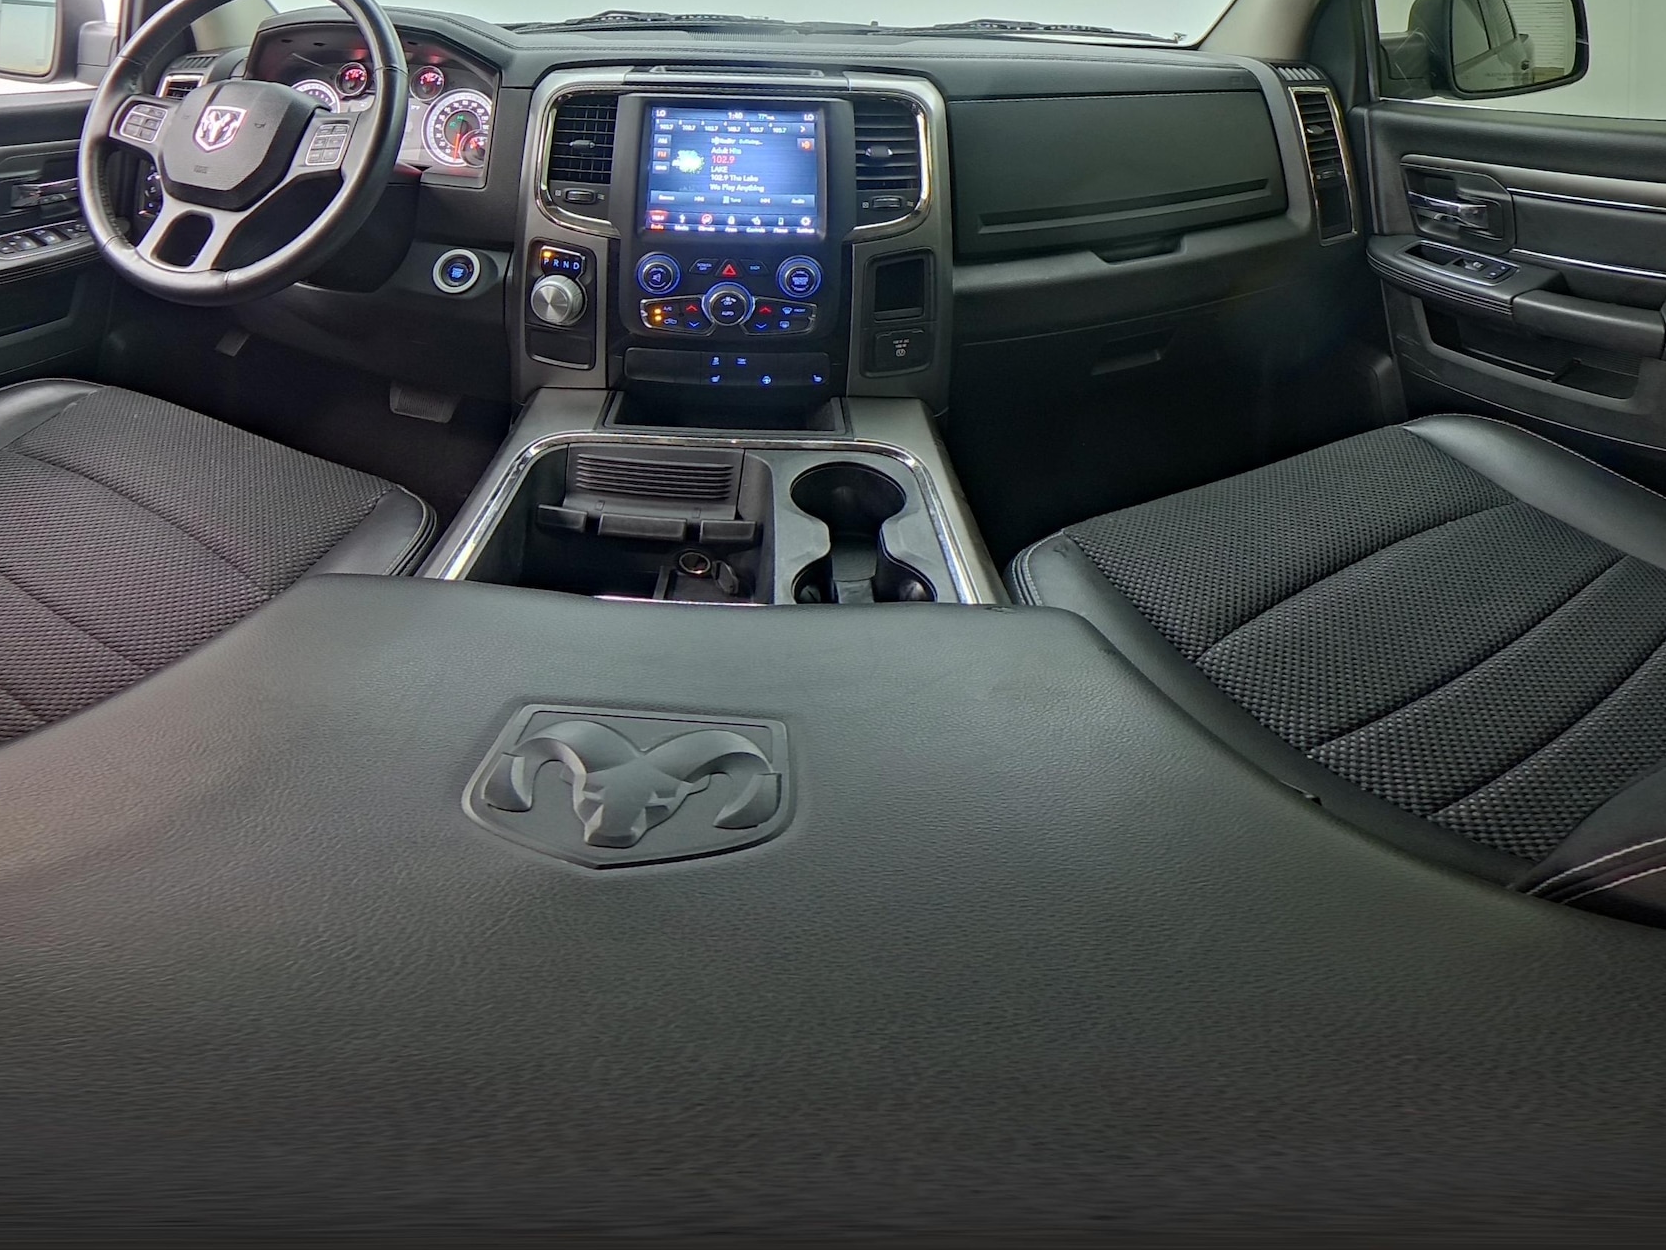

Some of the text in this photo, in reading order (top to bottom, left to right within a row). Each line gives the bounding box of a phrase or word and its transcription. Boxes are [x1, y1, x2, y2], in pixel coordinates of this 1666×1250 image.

[712, 155, 735, 164] 102.9
[711, 165, 729, 173] LAKE
[721, 184, 736, 192] Play
[736, 184, 765, 193] Anything
[544, 257, 580, 270] P R N D
